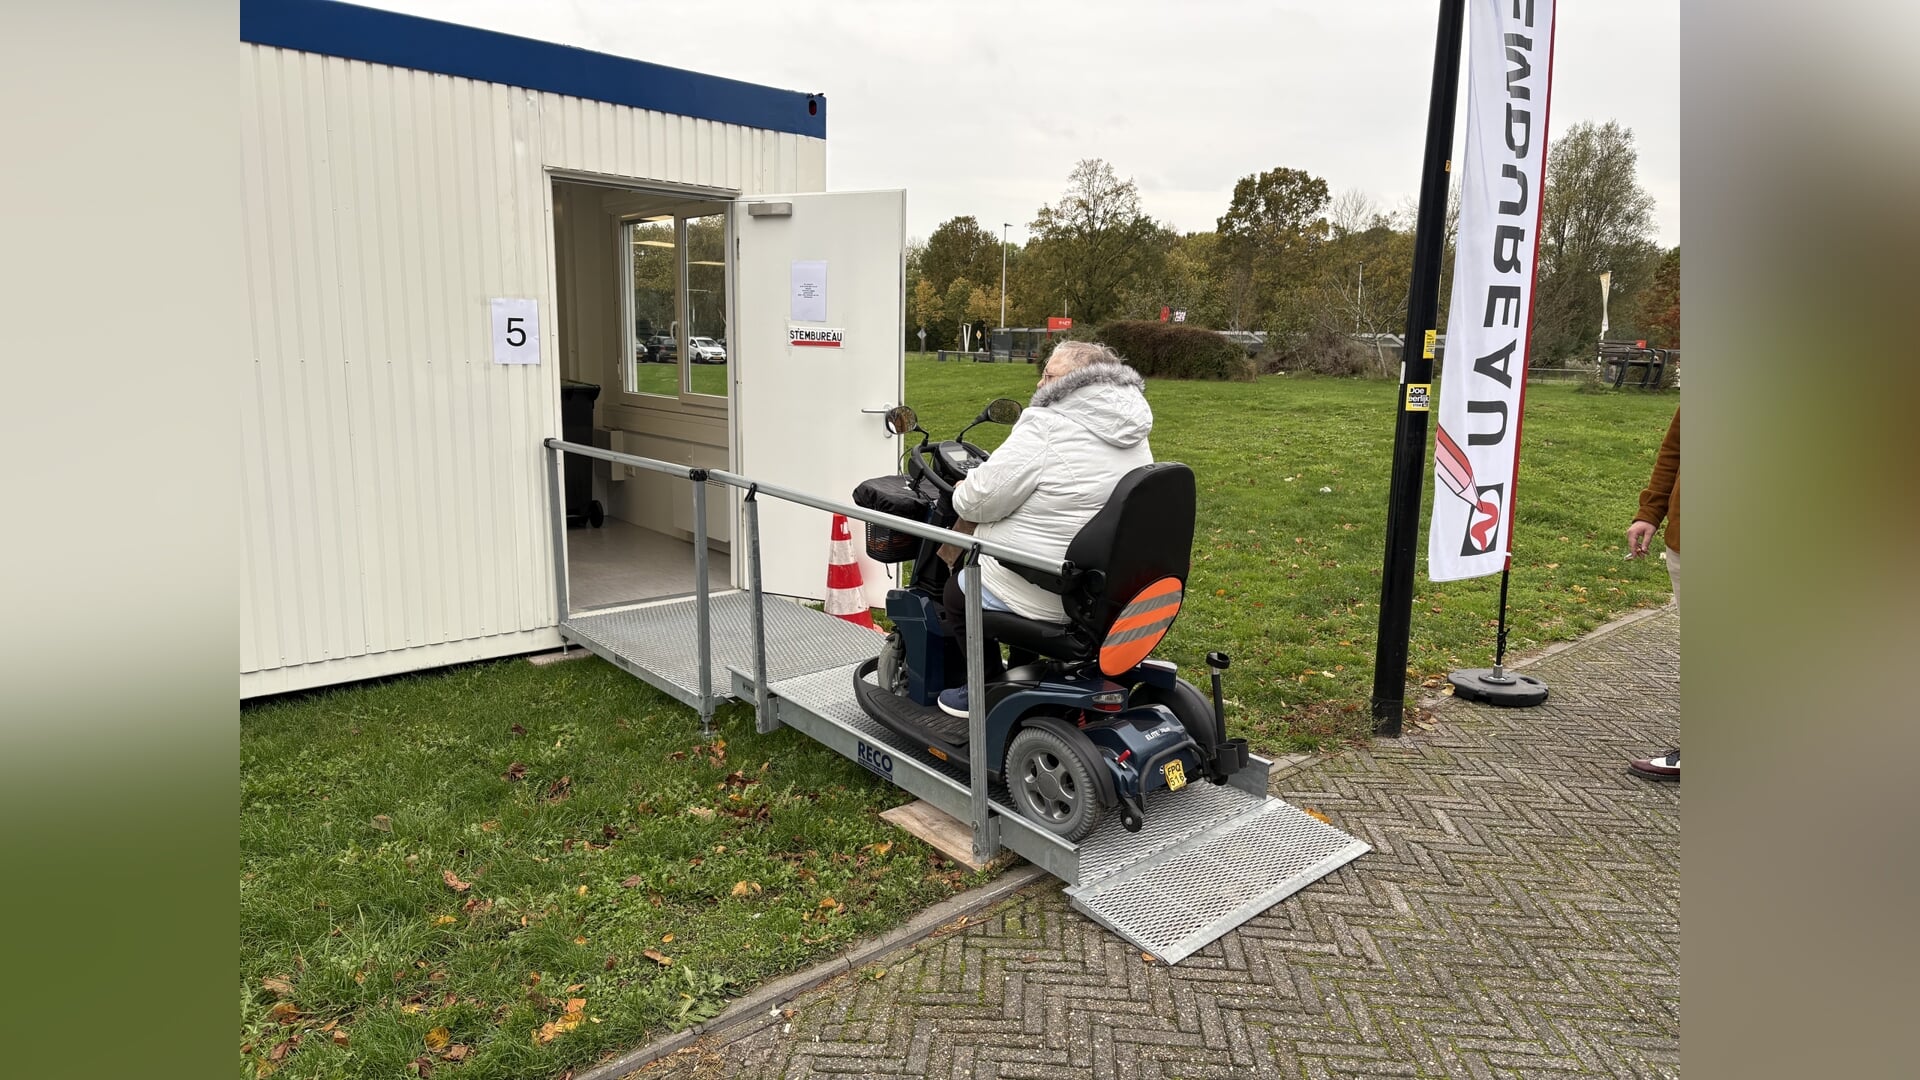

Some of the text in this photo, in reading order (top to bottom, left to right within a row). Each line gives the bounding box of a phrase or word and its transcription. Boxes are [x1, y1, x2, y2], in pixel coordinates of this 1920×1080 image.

[506, 317, 527, 347] 5
[789, 329, 843, 342] STEMBUREAU
[858, 741, 893, 772] RECO
[1169, 772, 1185, 787] 516
